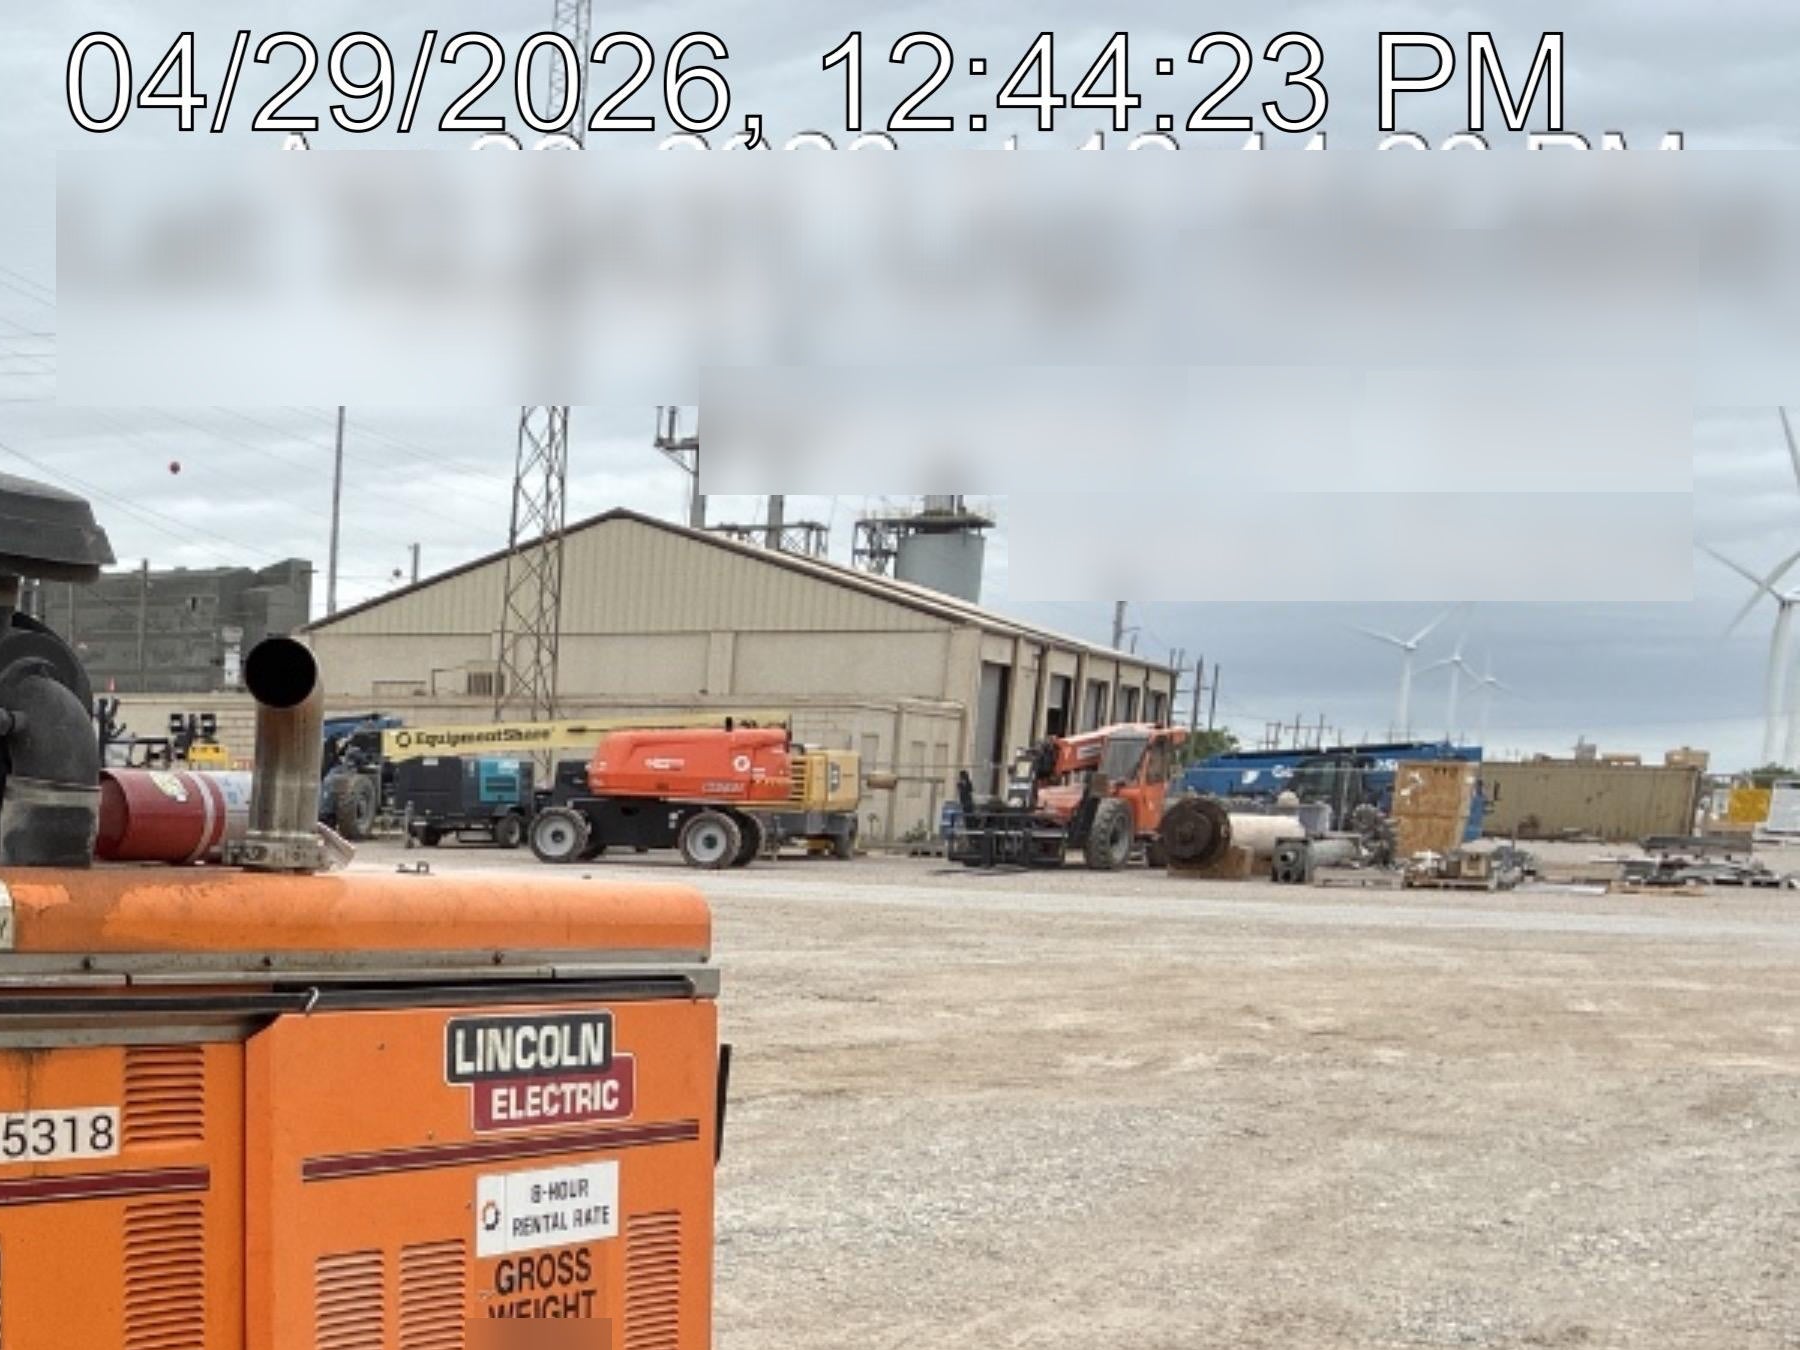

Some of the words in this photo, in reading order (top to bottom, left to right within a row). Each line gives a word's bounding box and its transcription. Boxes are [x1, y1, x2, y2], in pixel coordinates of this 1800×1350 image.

[415, 727, 550, 748] EquipmentShare
[454, 1022, 605, 1076] LINCOLN
[490, 1079, 620, 1121] ELECTRIC
[530, 1178, 589, 1204] 8-HOUR
[512, 1212, 568, 1237] RENTAL
[573, 1205, 610, 1228] RATE
[495, 1247, 593, 1296] GROSS
